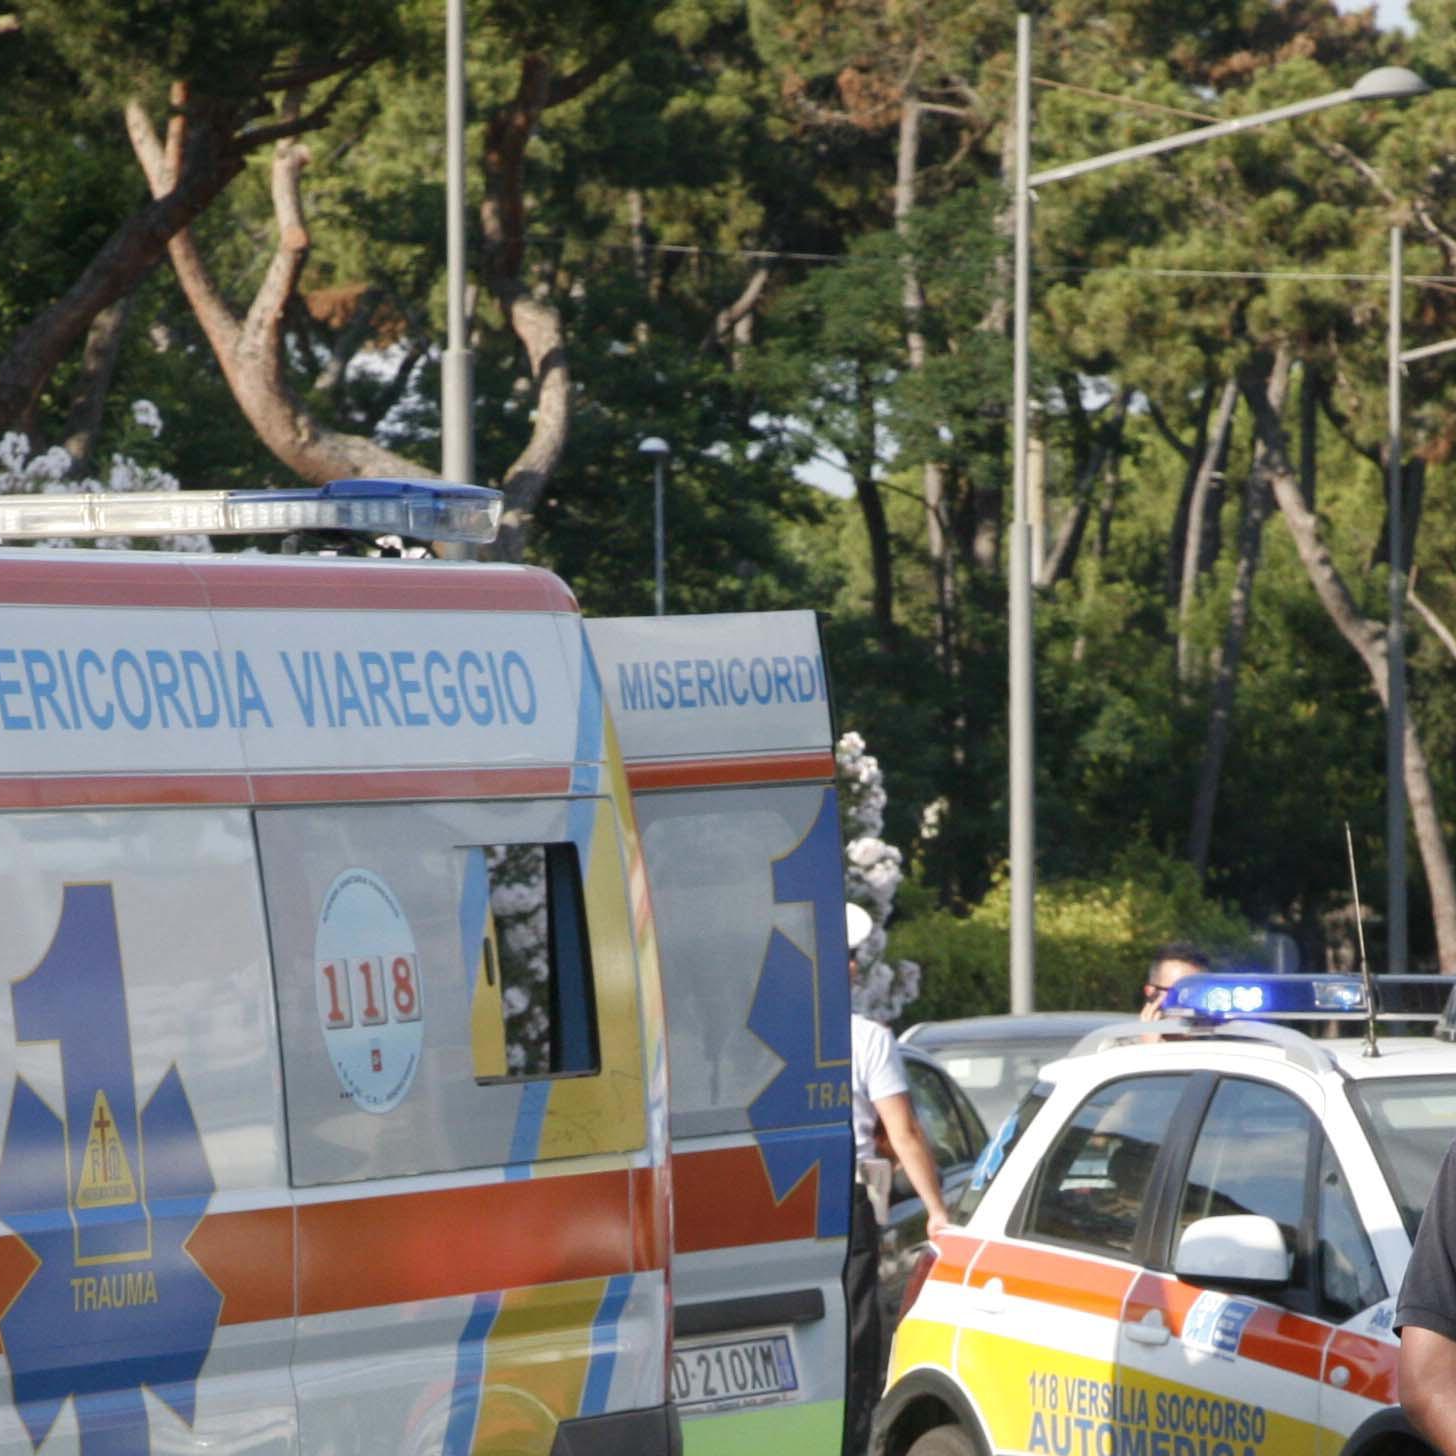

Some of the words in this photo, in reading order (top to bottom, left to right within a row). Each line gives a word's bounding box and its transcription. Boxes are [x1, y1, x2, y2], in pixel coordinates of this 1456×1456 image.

[278, 649, 537, 728] VIAREGGIO
[617, 654, 827, 711] MISERICORDI
[323, 956, 416, 1022] 118
[70, 1270, 159, 1312] TRAUMA
[1029, 1371, 1059, 1410] 118
[1064, 1376, 1150, 1427] VERSILIA
[1155, 1391, 1267, 1445] SOCCORSO
